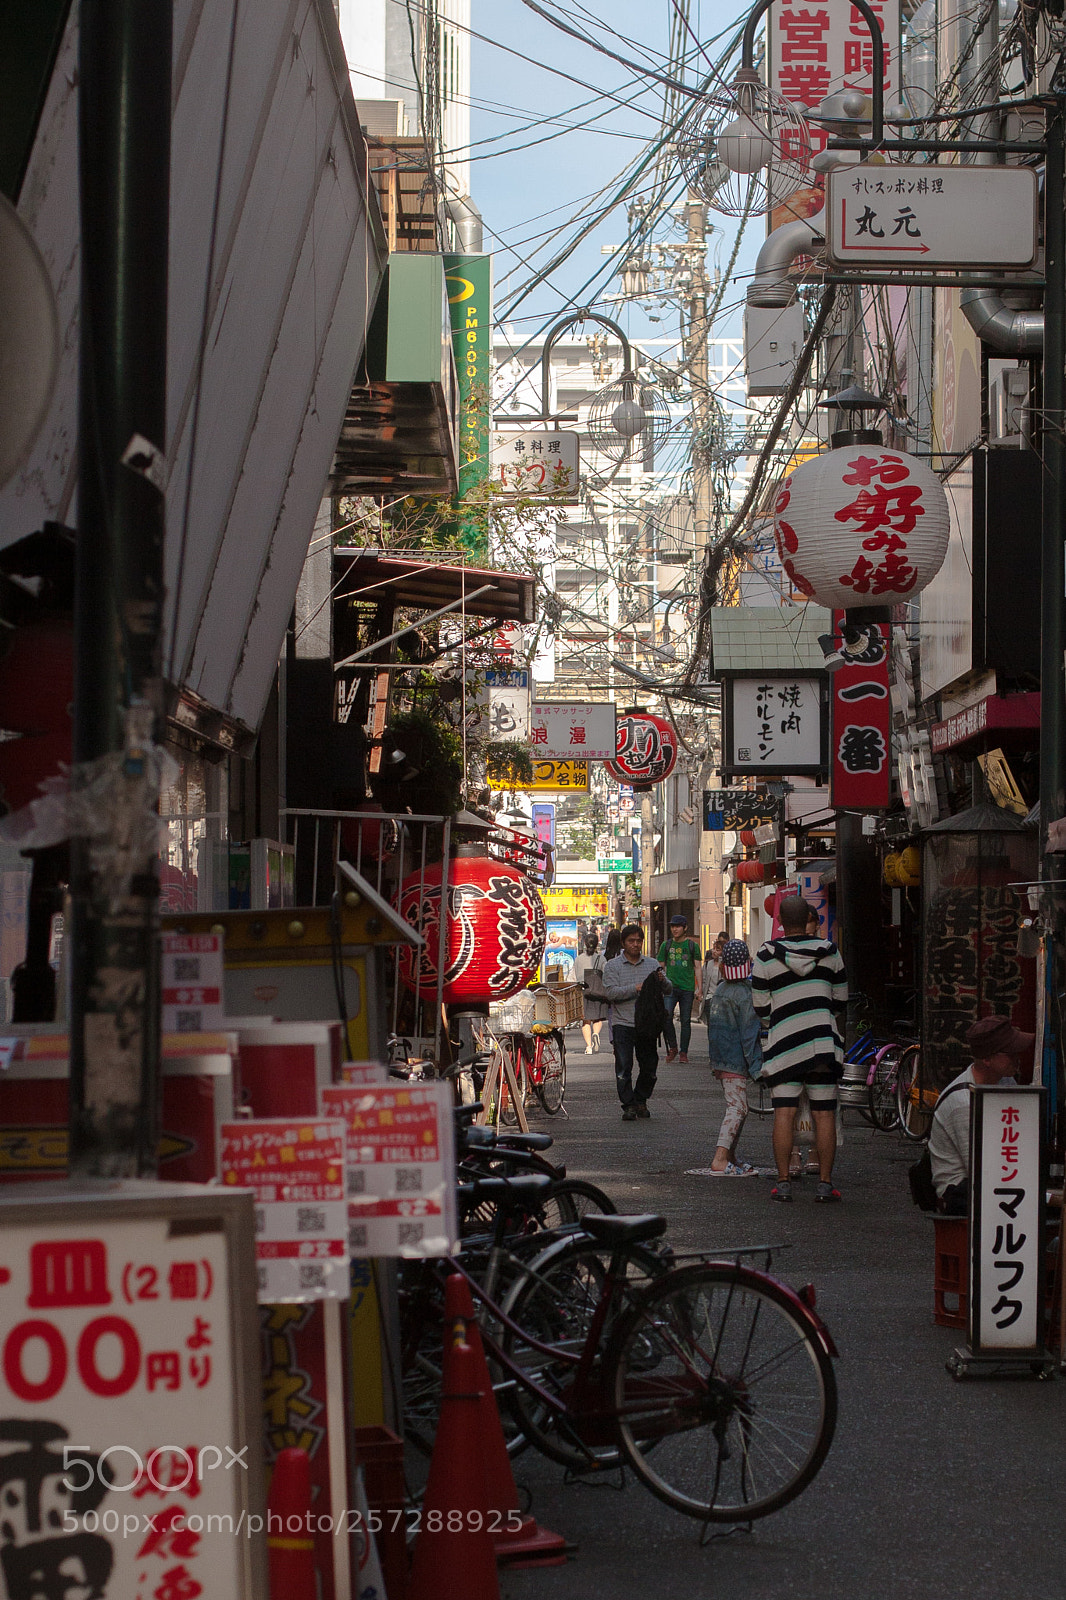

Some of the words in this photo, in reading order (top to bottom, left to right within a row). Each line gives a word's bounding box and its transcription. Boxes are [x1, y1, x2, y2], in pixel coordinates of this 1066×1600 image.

[778, 0, 831, 174] 営業中
[852, 177, 945, 194] すし・スッポン料理
[855, 205, 922, 238] 丸元
[514, 439, 562, 455] 串料理
[835, 454, 925, 595] お好み焼
[531, 727, 586, 745] 浪漫
[756, 684, 775, 761] ホルモン
[778, 684, 804, 735] 焼肉
[557, 772, 587, 786] 名物
[488, 875, 528, 995] やきとり
[1001, 1106, 1020, 1182] ホルモン
[991, 1187, 1027, 1330] マルフク
